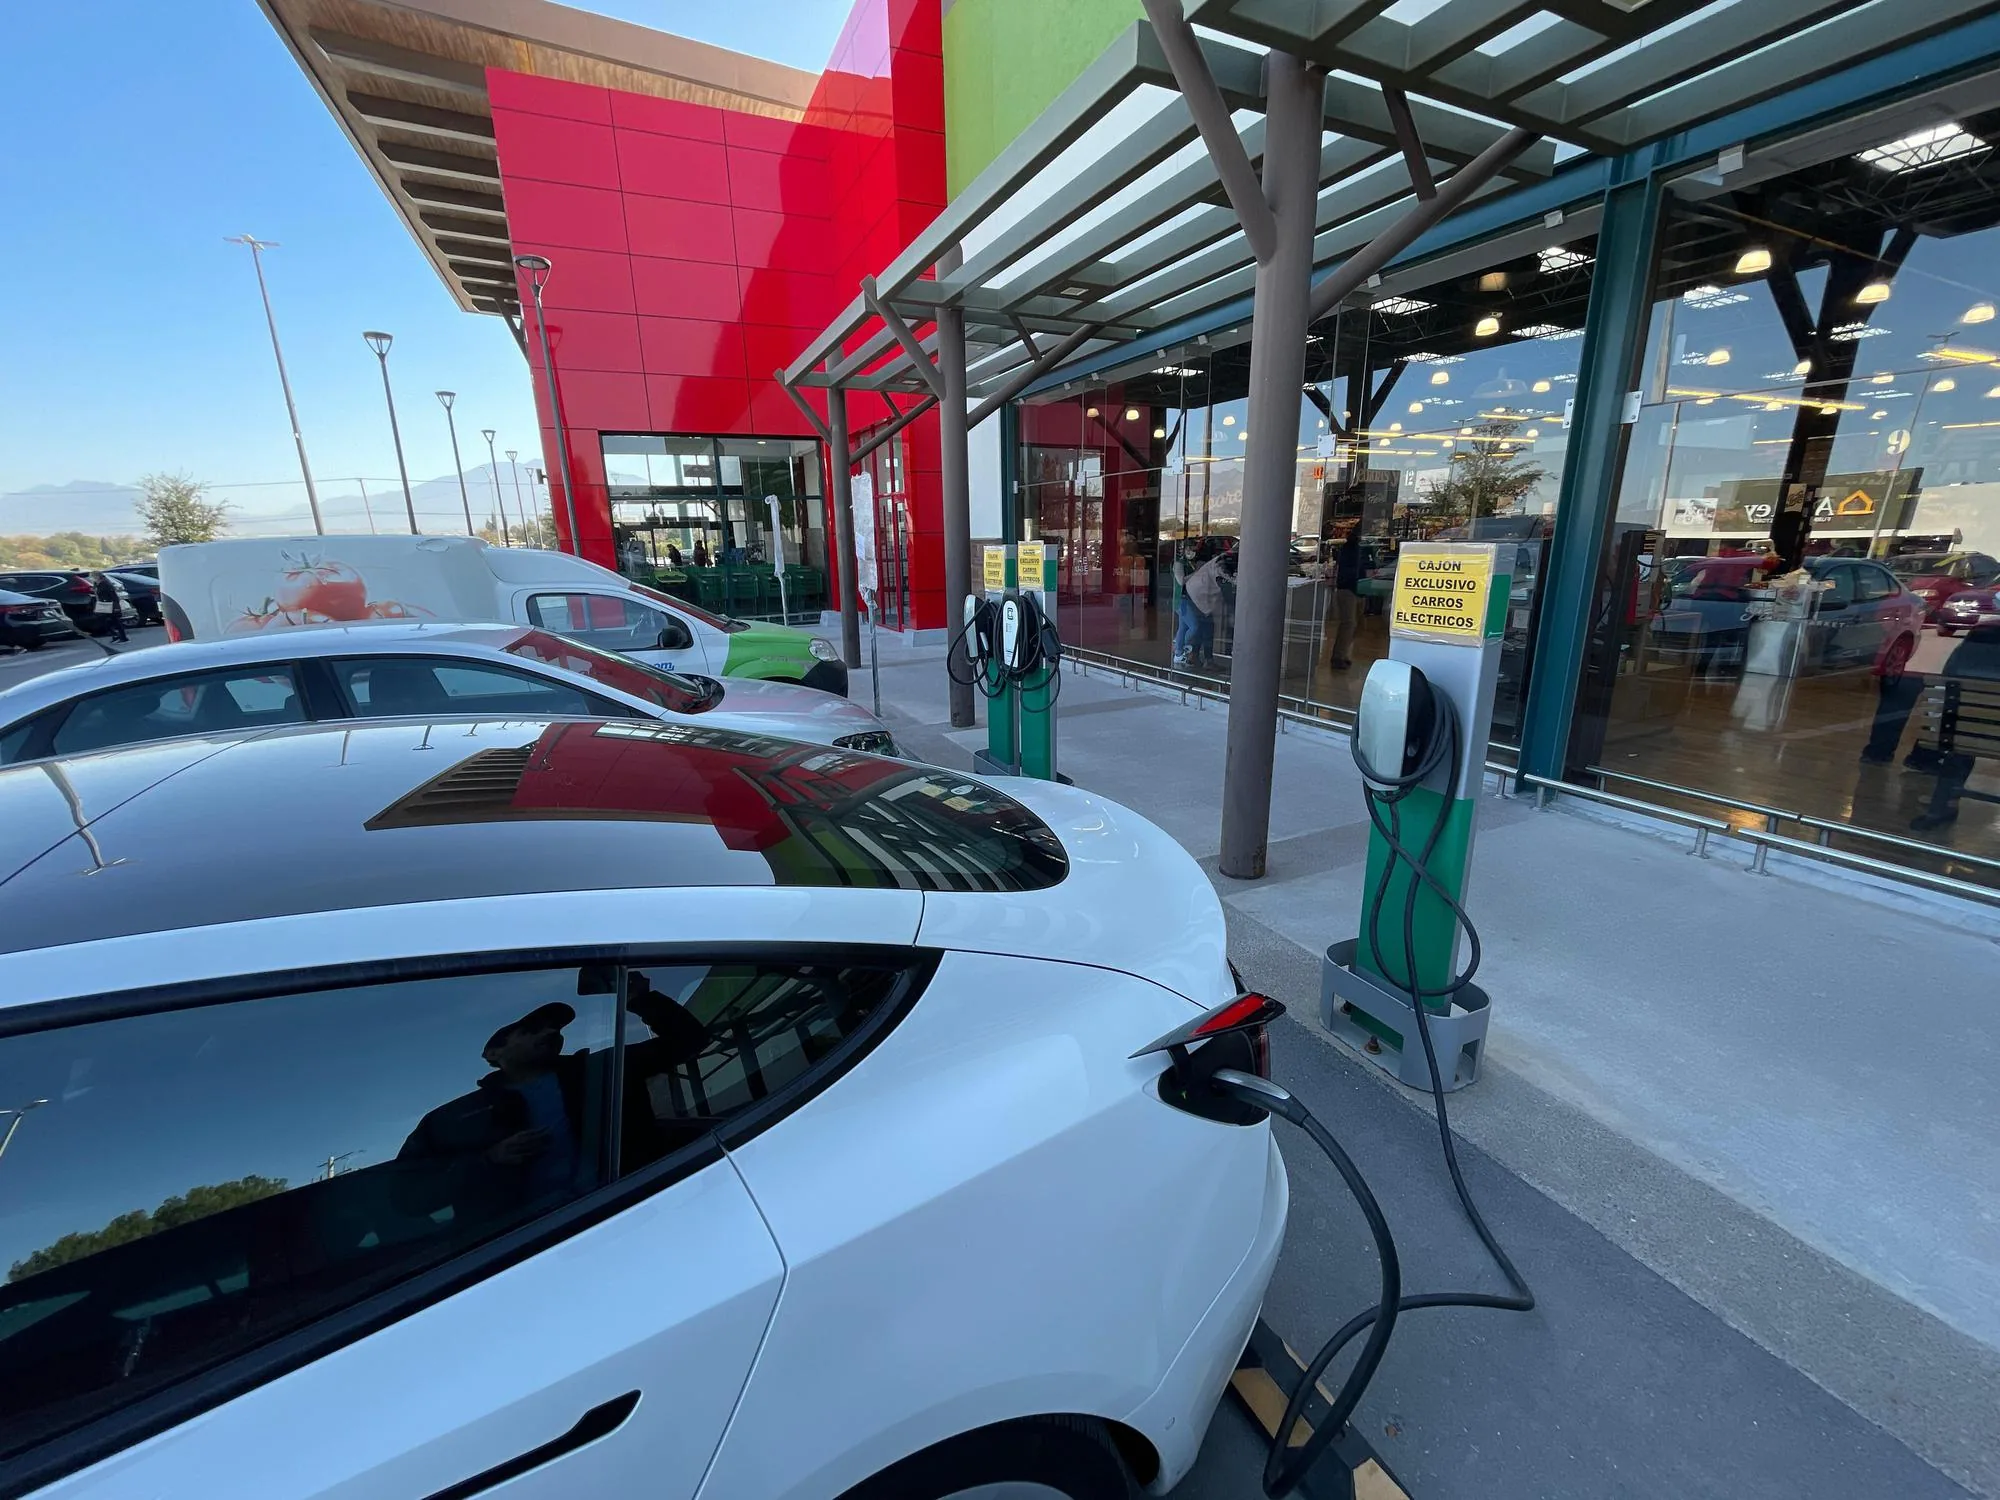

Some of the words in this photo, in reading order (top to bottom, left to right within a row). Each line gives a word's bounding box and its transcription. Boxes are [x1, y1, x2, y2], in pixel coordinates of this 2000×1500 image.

[1887, 429, 1910, 455] 9
[1406, 577, 1476, 591] EXCLUSIVO
[1413, 596, 1463, 608] CARROS
[1396, 612, 1474, 628] ELECTRICOS
